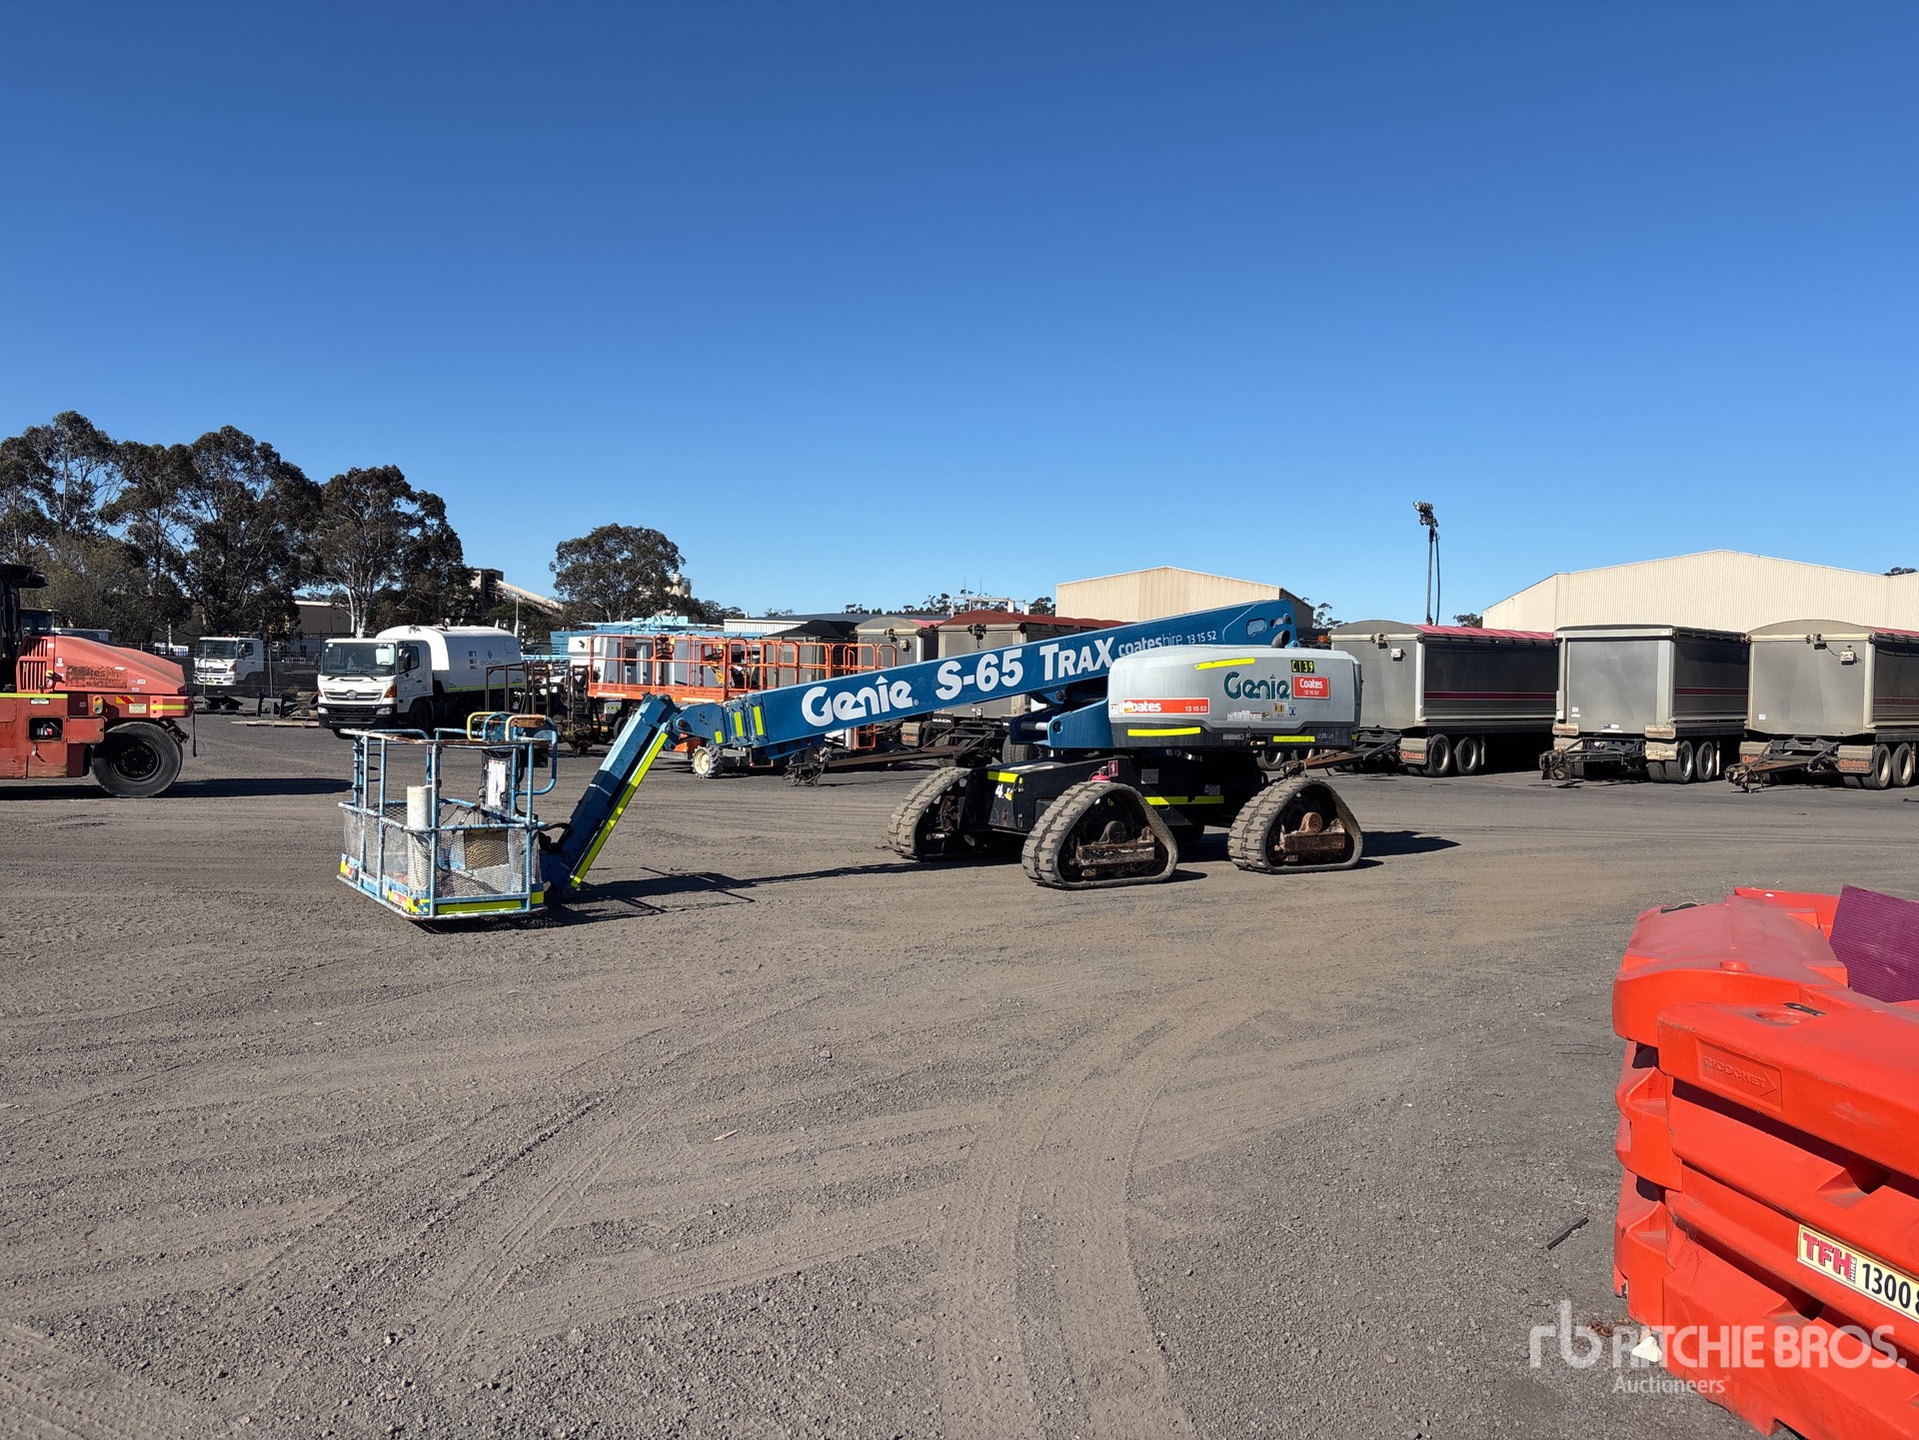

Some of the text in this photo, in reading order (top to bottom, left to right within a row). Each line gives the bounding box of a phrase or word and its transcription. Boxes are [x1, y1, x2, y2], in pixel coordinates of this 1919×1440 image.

[1187, 634, 1195, 644] 13
[1197, 632, 1206, 643] 15
[1207, 630, 1217, 641] 52
[801, 675, 913, 727] Genie
[935, 648, 1024, 700] S-65
[1223, 671, 1291, 700] Genie
[1299, 678, 1323, 689] Coates
[1124, 701, 1162, 713] oates
[1802, 1231, 1852, 1280] TFH
